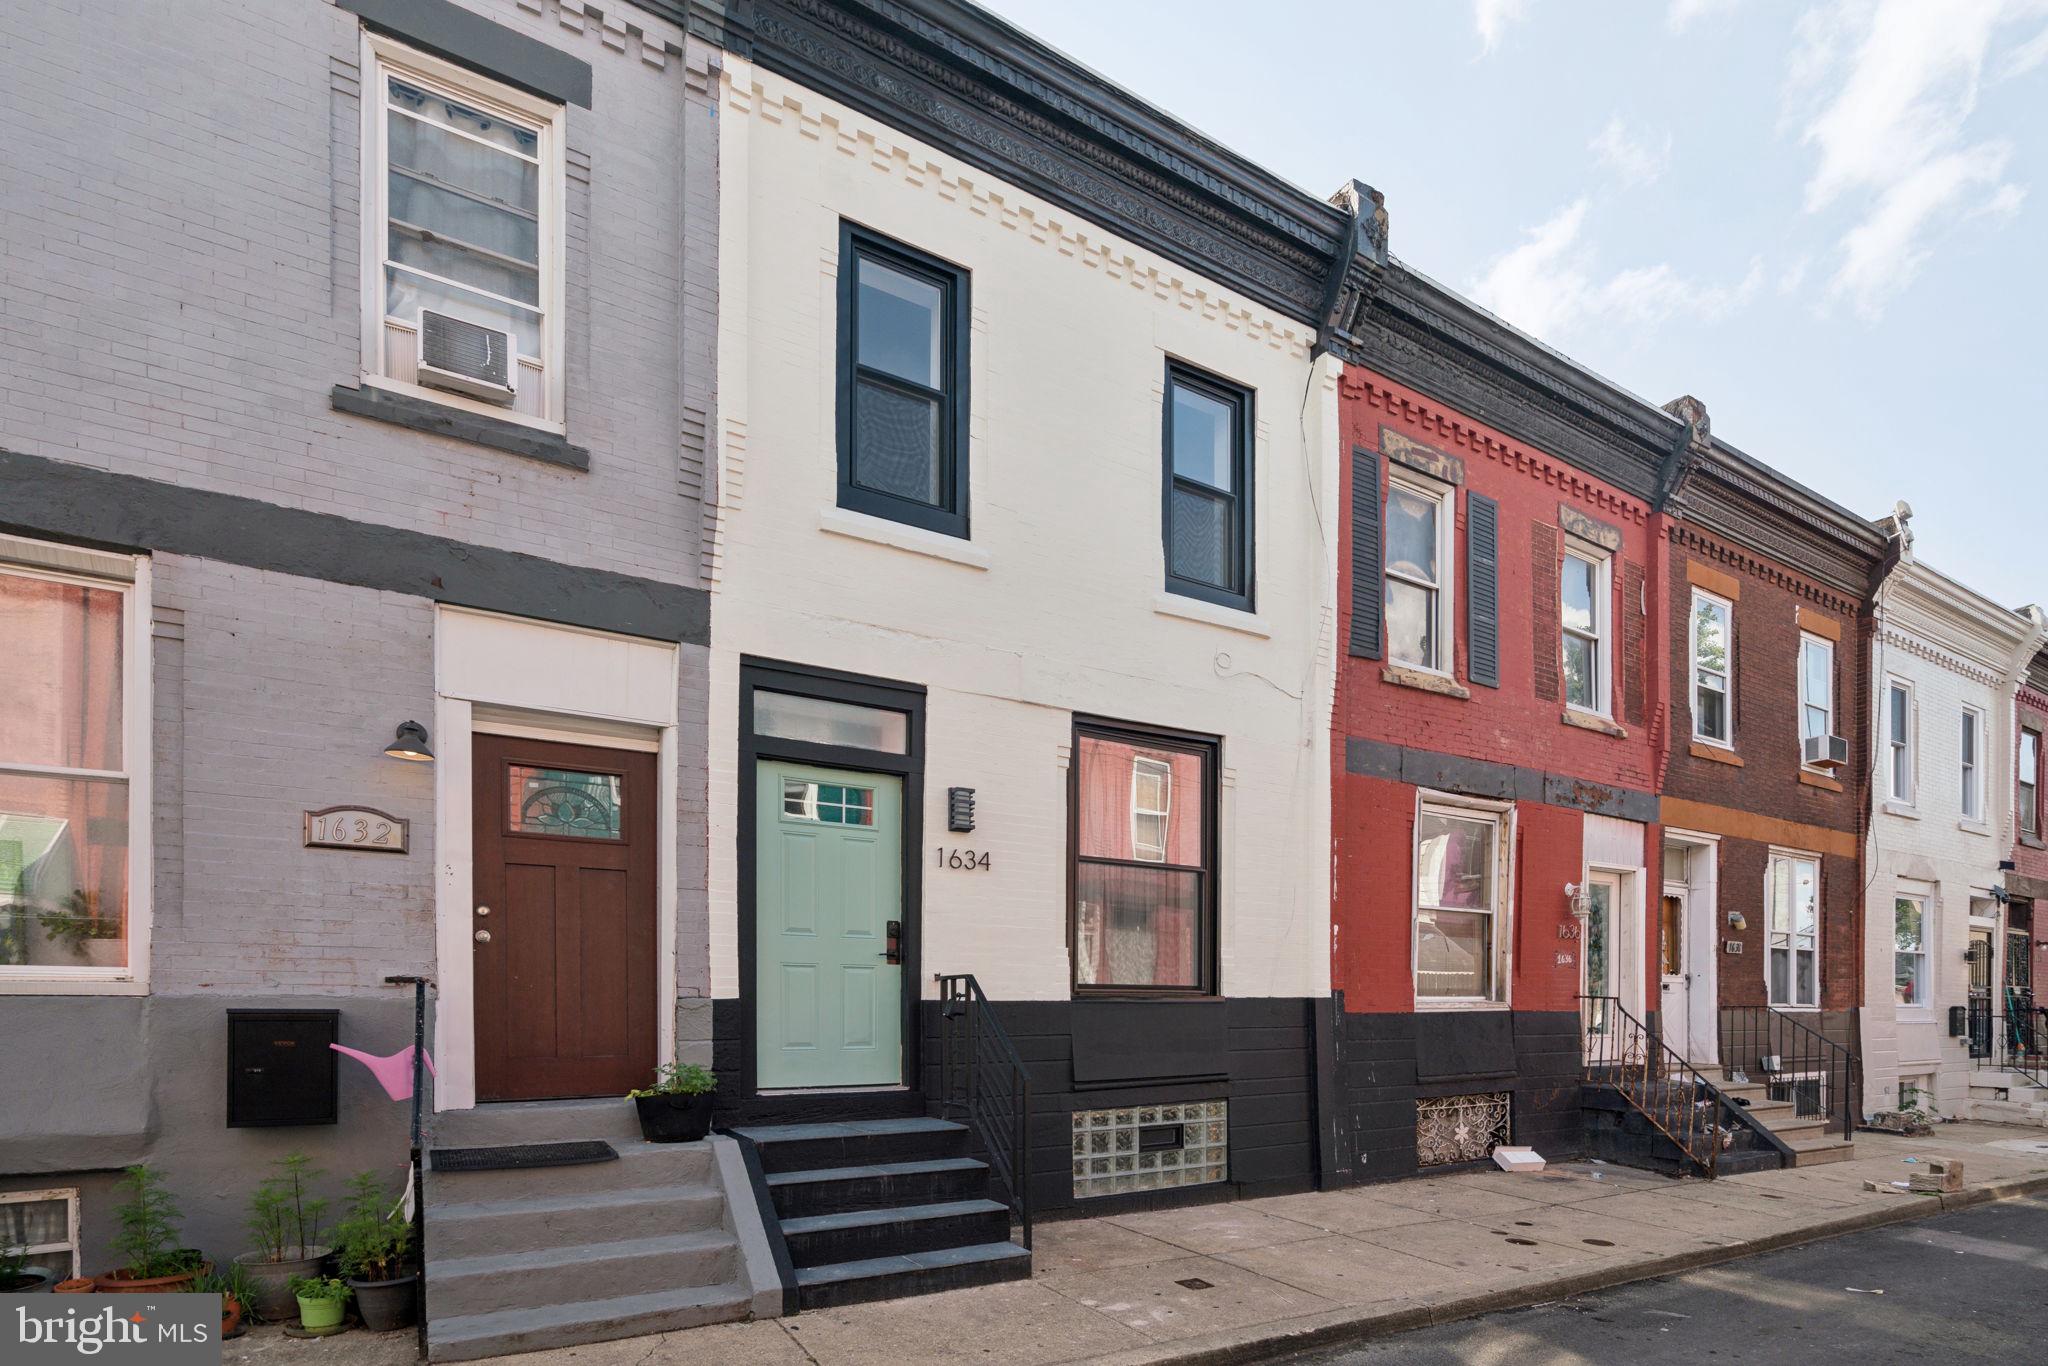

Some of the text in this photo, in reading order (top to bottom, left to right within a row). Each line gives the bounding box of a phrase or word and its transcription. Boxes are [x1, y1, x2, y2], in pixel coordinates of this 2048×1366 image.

[318, 816, 391, 844] 1632
[937, 847, 991, 871] 1634
[1559, 924, 1580, 939] 1636
